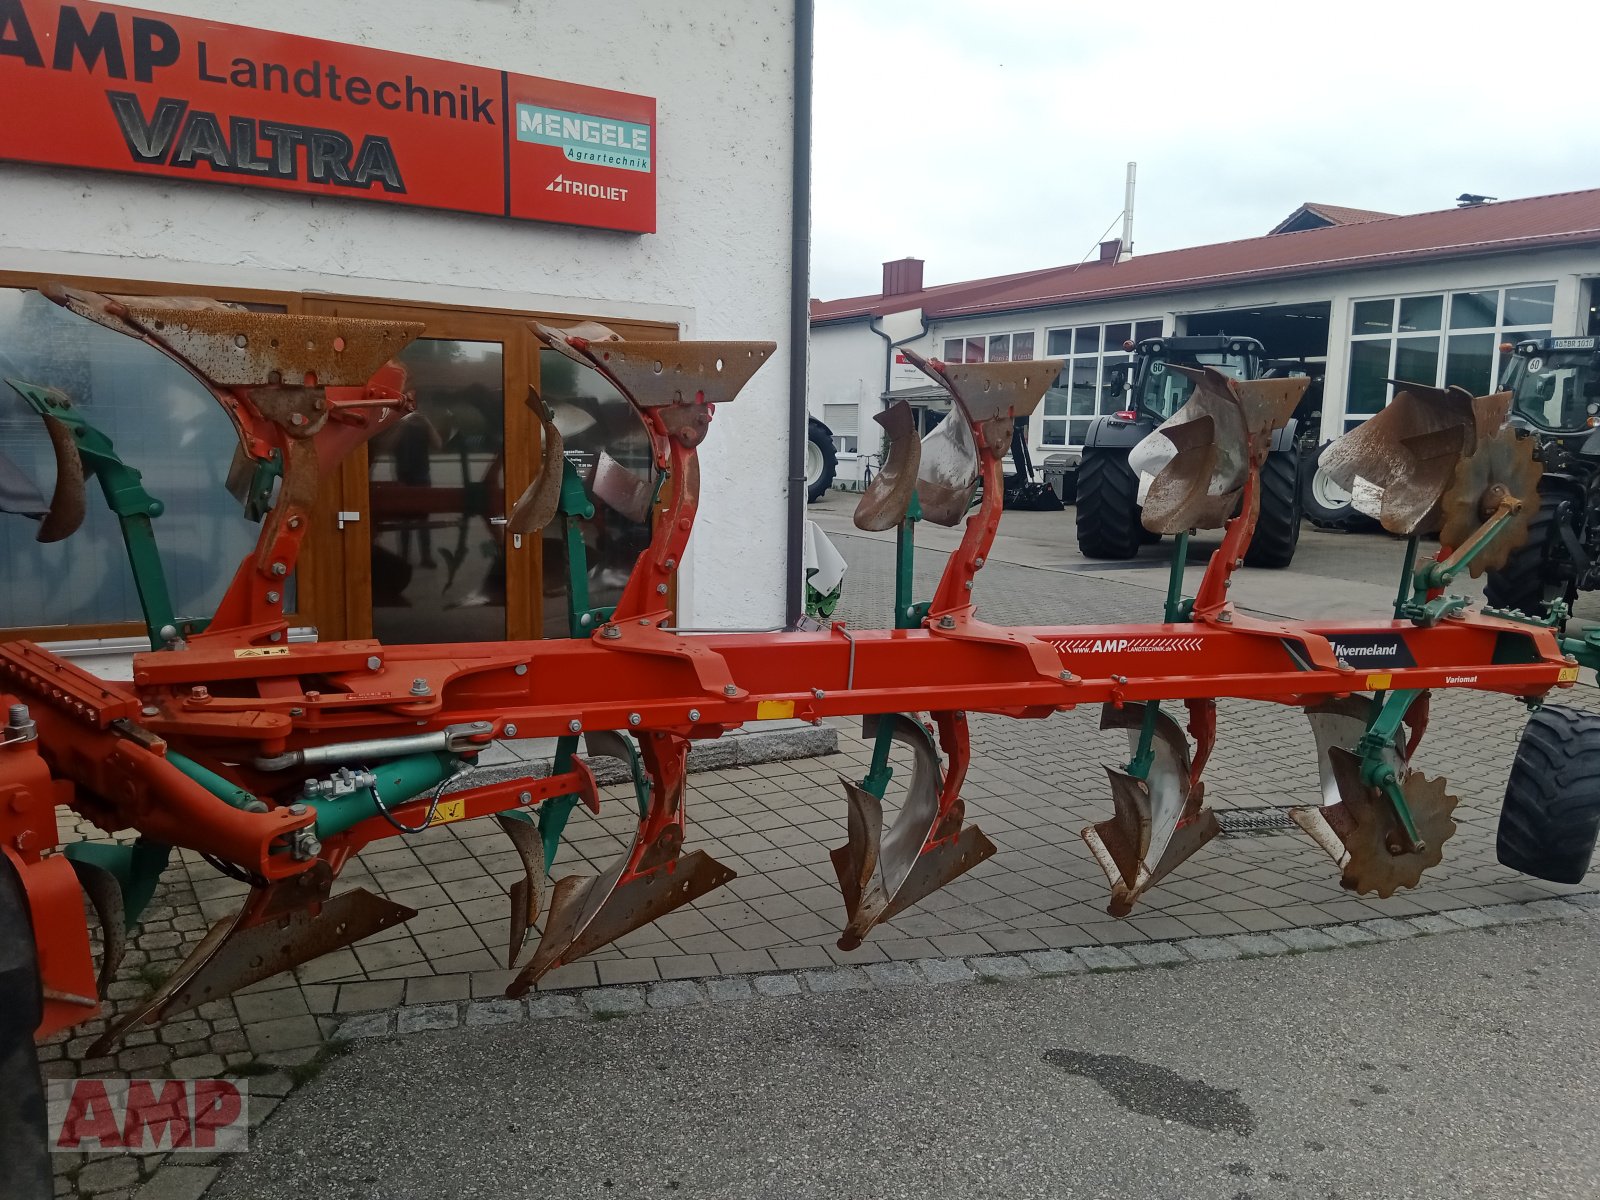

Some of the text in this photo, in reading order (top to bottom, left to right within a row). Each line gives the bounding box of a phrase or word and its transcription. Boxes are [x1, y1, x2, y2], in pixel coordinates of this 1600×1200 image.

[0, 0, 496, 126] AMP Landtechnik
[520, 110, 647, 151] MENGELE
[104, 89, 407, 195] VALTRA
[567, 148, 647, 169] Agrartechnik
[562, 180, 628, 202] TRIOLIET
[1529, 359, 1540, 370] 60
[1335, 643, 1398, 656] Kverneland
[1445, 675, 1478, 684] Variomat
